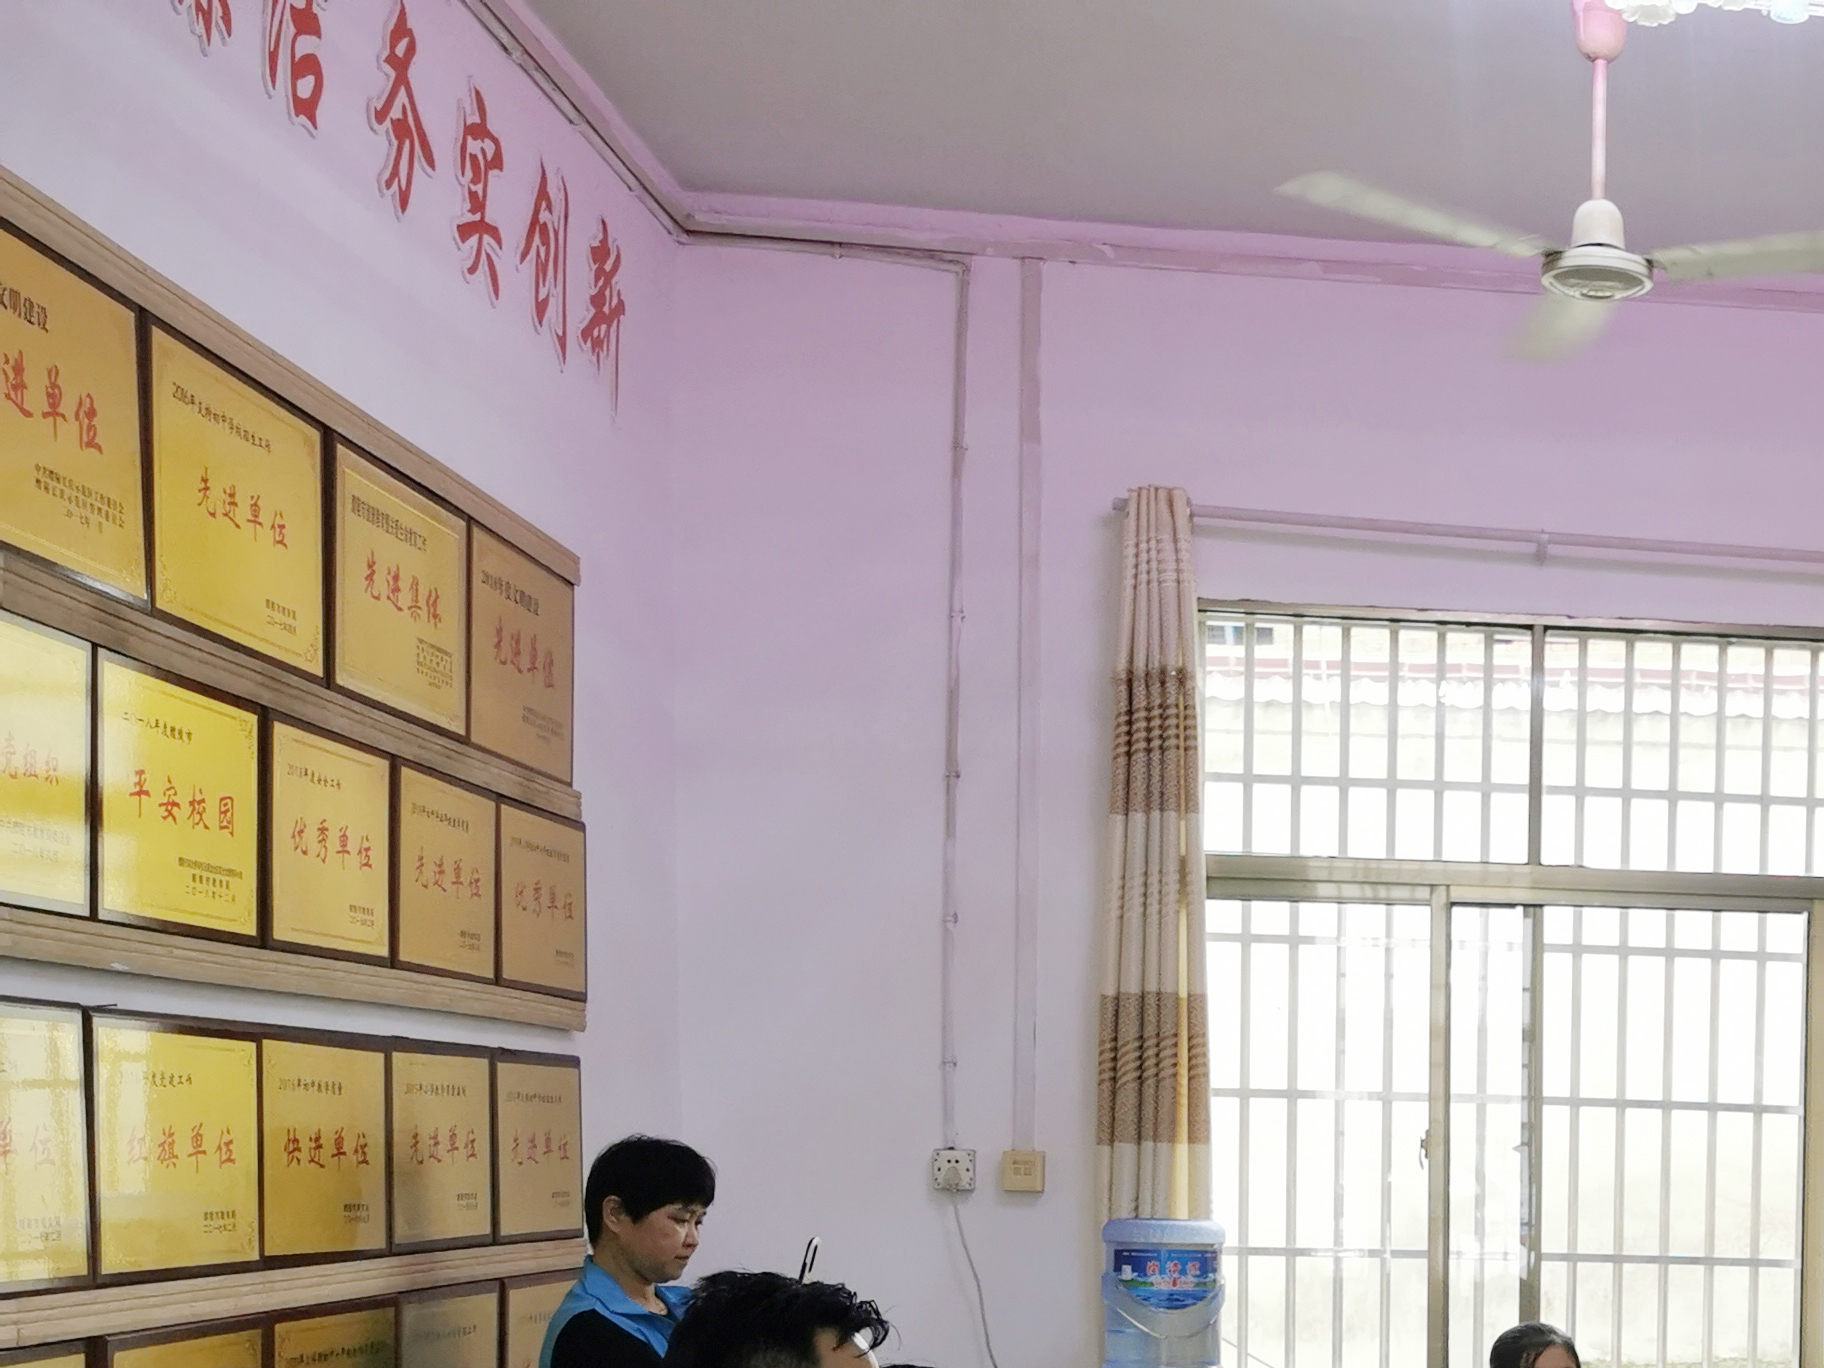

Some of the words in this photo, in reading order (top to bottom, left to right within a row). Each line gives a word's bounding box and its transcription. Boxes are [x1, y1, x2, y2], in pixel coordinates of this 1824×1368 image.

[172, 0, 624, 418] 洁务实创新
[197, 466, 288, 550] 先进单位
[364, 549, 442, 630] 先进集体
[494, 615, 555, 689] 先进单位
[129, 769, 235, 838] 平安校园
[291, 816, 374, 871] 优秀单位
[415, 846, 482, 900] 先进单位
[127, 1122, 236, 1174] 红旗单位
[283, 1126, 370, 1171] 快进单位
[409, 1124, 478, 1168] 先进单位
[510, 1127, 570, 1168] 先进单位
